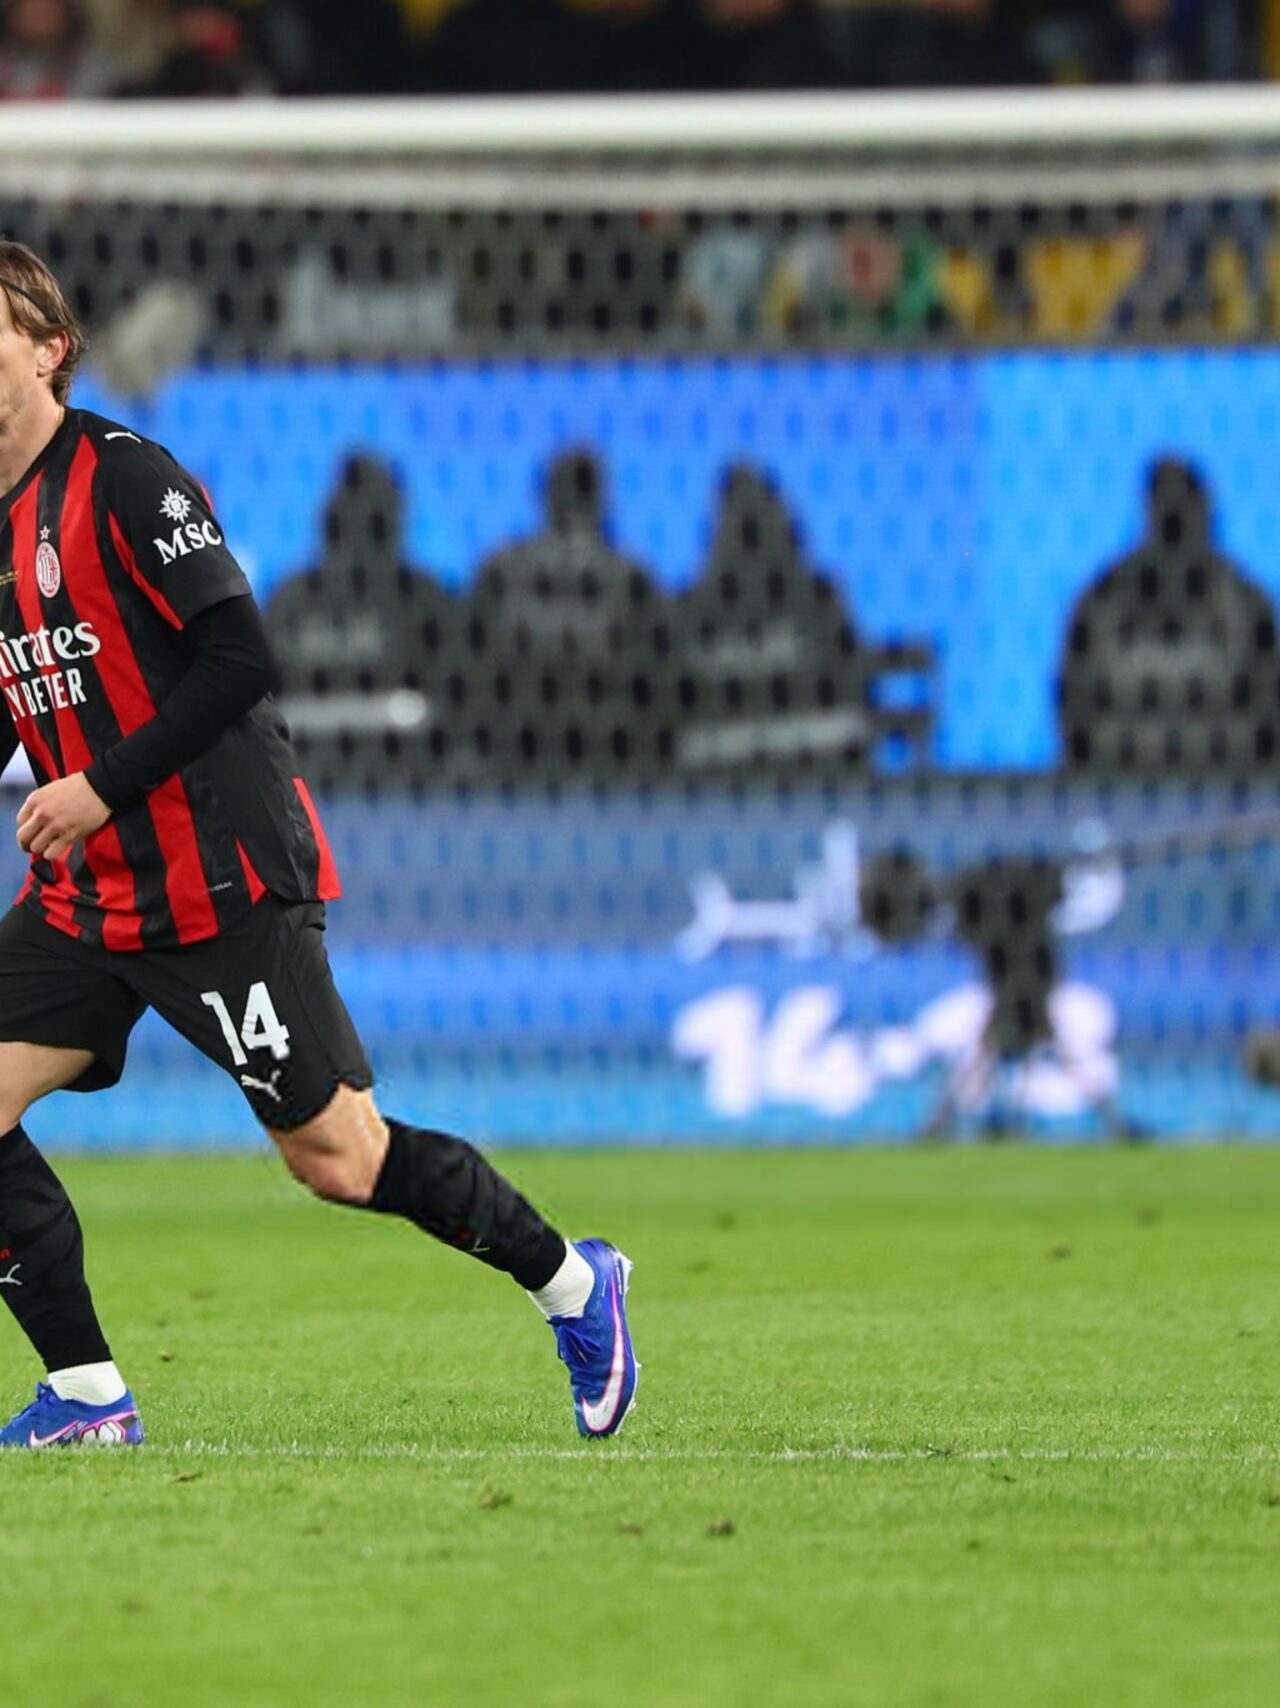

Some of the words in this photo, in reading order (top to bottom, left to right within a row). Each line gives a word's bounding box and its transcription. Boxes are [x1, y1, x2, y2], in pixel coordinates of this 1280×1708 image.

[152, 519, 222, 566] MSC
[20, 667, 87, 716] BETER
[200, 981, 291, 1067] 14
